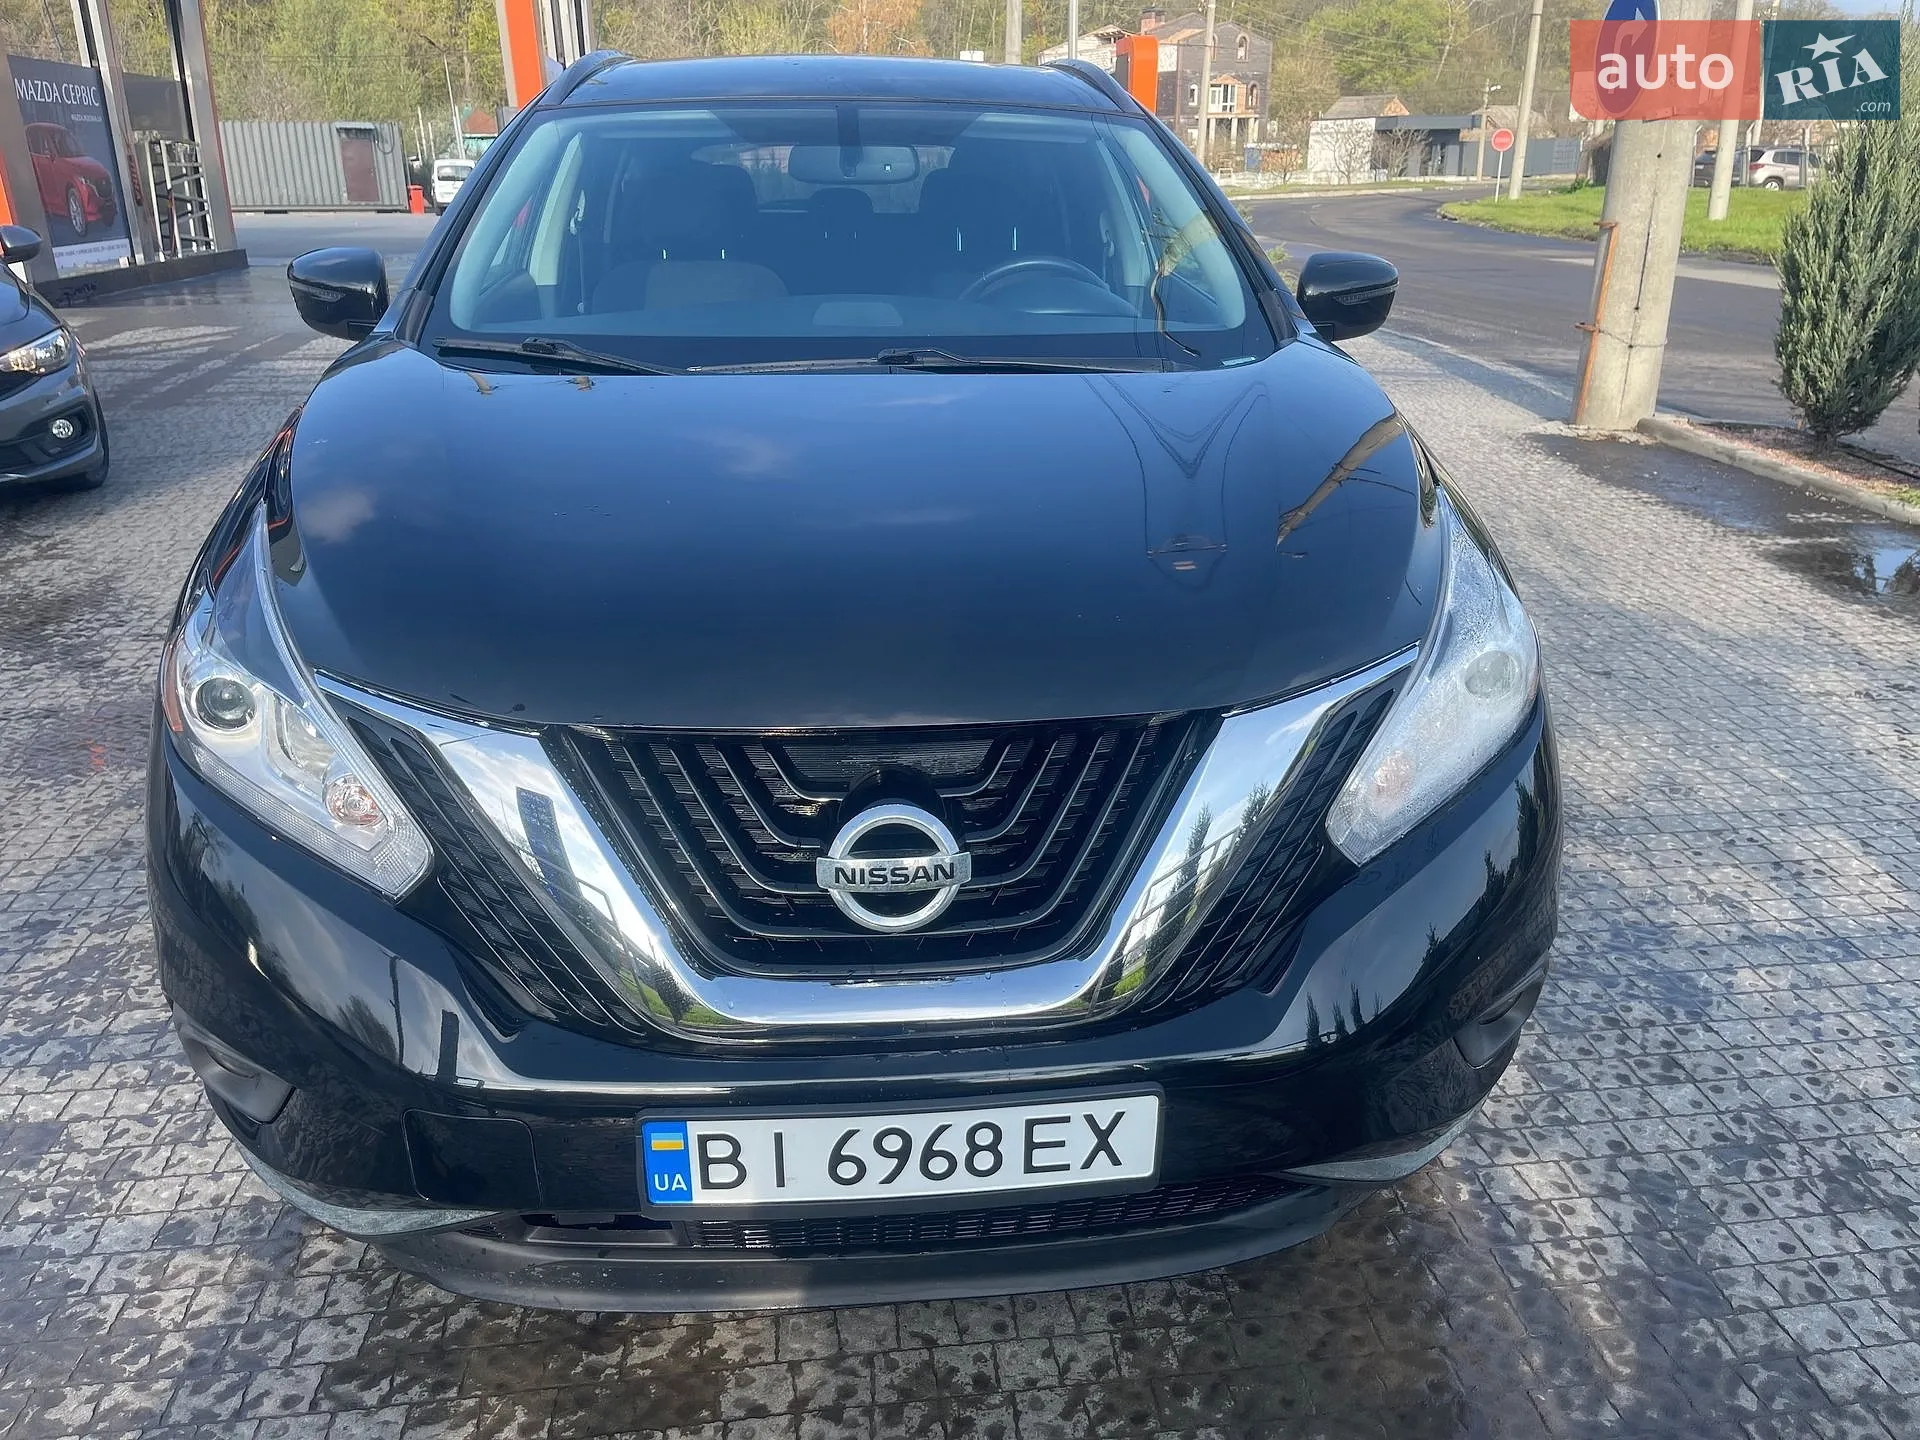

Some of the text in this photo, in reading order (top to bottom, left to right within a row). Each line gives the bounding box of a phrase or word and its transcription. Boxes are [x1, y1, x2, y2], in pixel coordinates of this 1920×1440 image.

[14, 77, 100, 107] MAZDA СЕРВІС
[834, 862, 955, 885] NISSAN
[827, 1121, 1003, 1187] 6968
[1023, 1109, 1127, 1175] EX
[654, 1173, 688, 1191] UA
